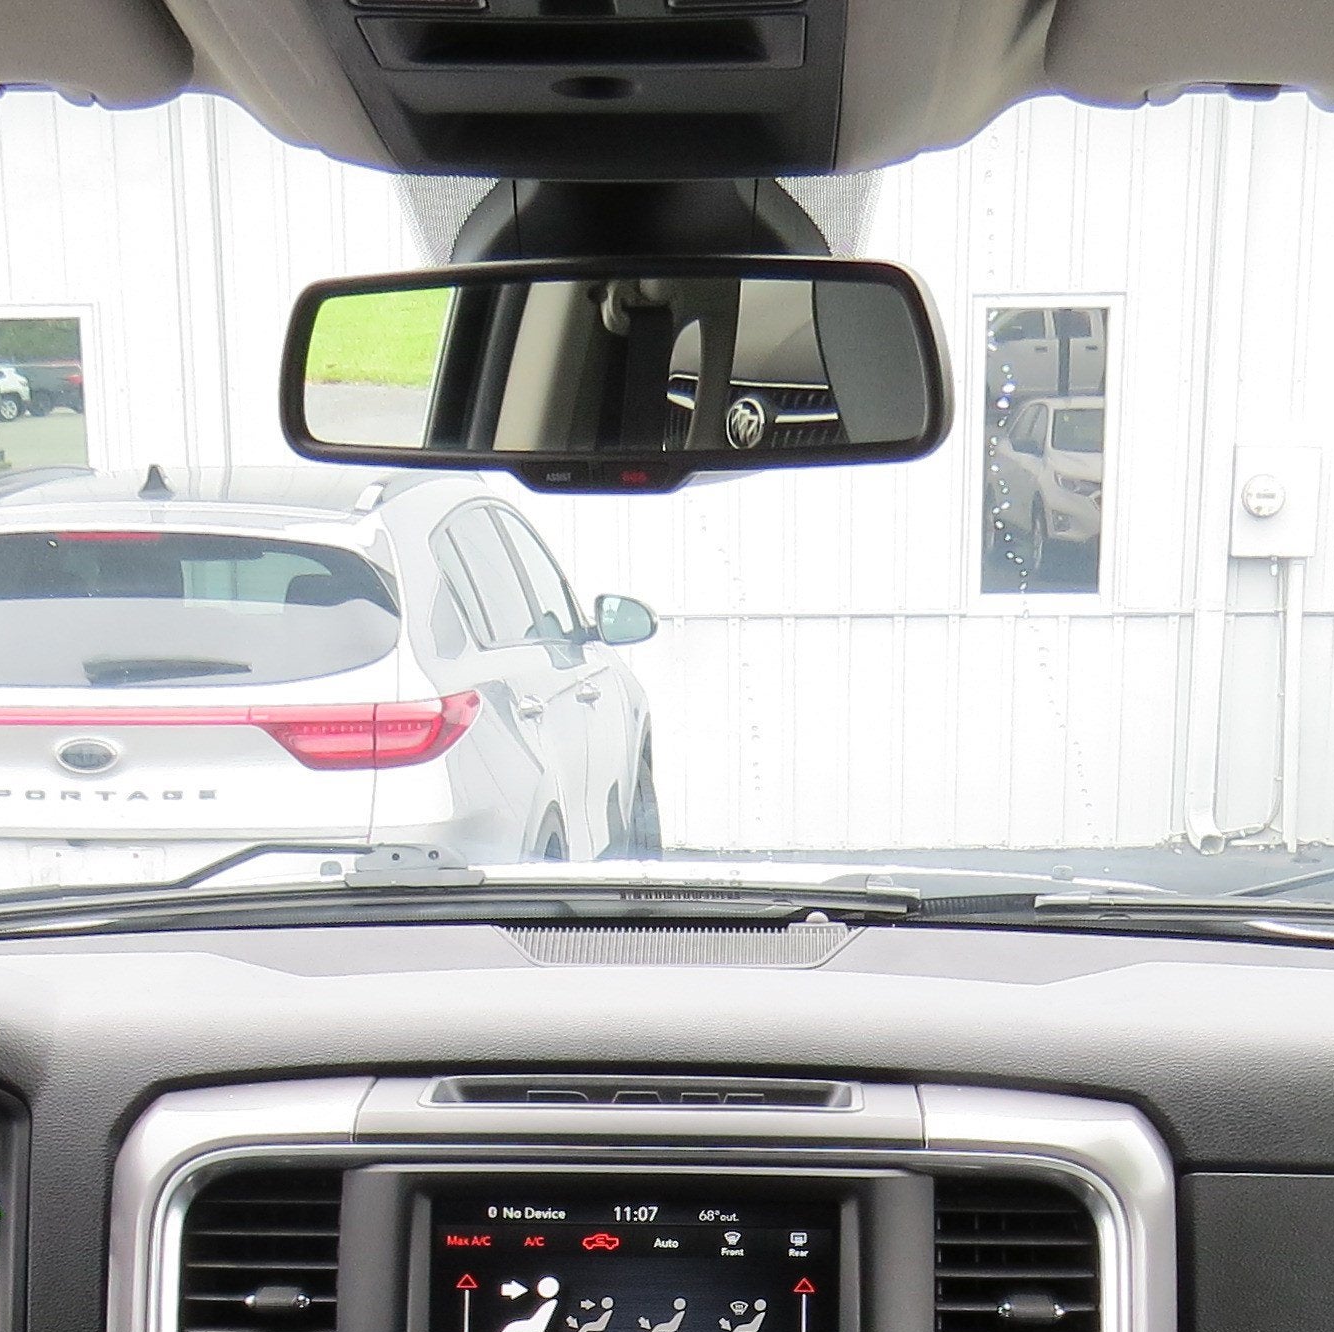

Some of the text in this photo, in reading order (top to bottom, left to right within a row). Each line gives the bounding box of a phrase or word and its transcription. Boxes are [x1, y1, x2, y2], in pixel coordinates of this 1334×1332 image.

[503, 1206, 567, 1220] No Device
[613, 1206, 659, 1222] 11:07
[446, 1235, 492, 1247] Max A/C
[524, 1236, 545, 1247] A/C
[653, 1237, 680, 1249] Auto
[720, 1247, 745, 1257] Front
[788, 1248, 810, 1258] Rear
